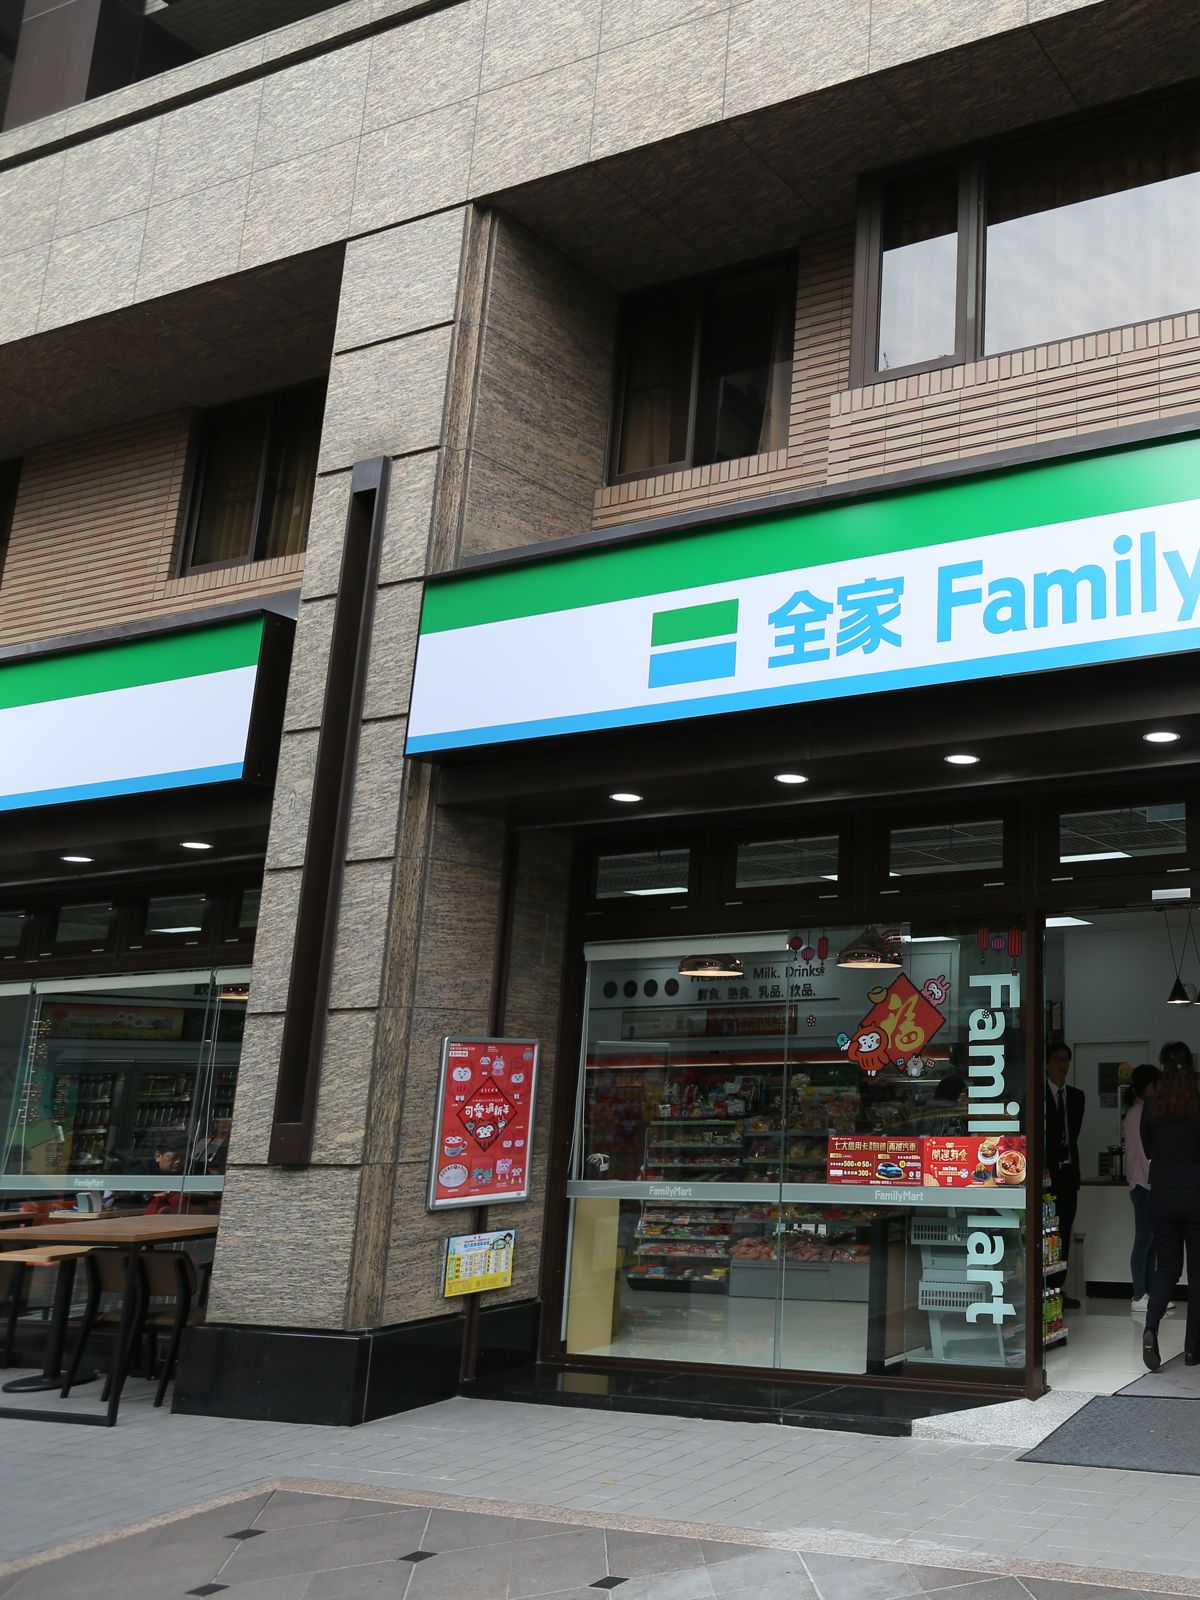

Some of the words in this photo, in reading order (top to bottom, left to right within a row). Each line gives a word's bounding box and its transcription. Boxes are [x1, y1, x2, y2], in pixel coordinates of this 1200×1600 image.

[767, 576, 905, 669] 全家
[753, 967, 780, 980] Milk.
[648, 1185, 692, 1198] FamilyMart
[874, 1189, 925, 1202] FamilyMart
